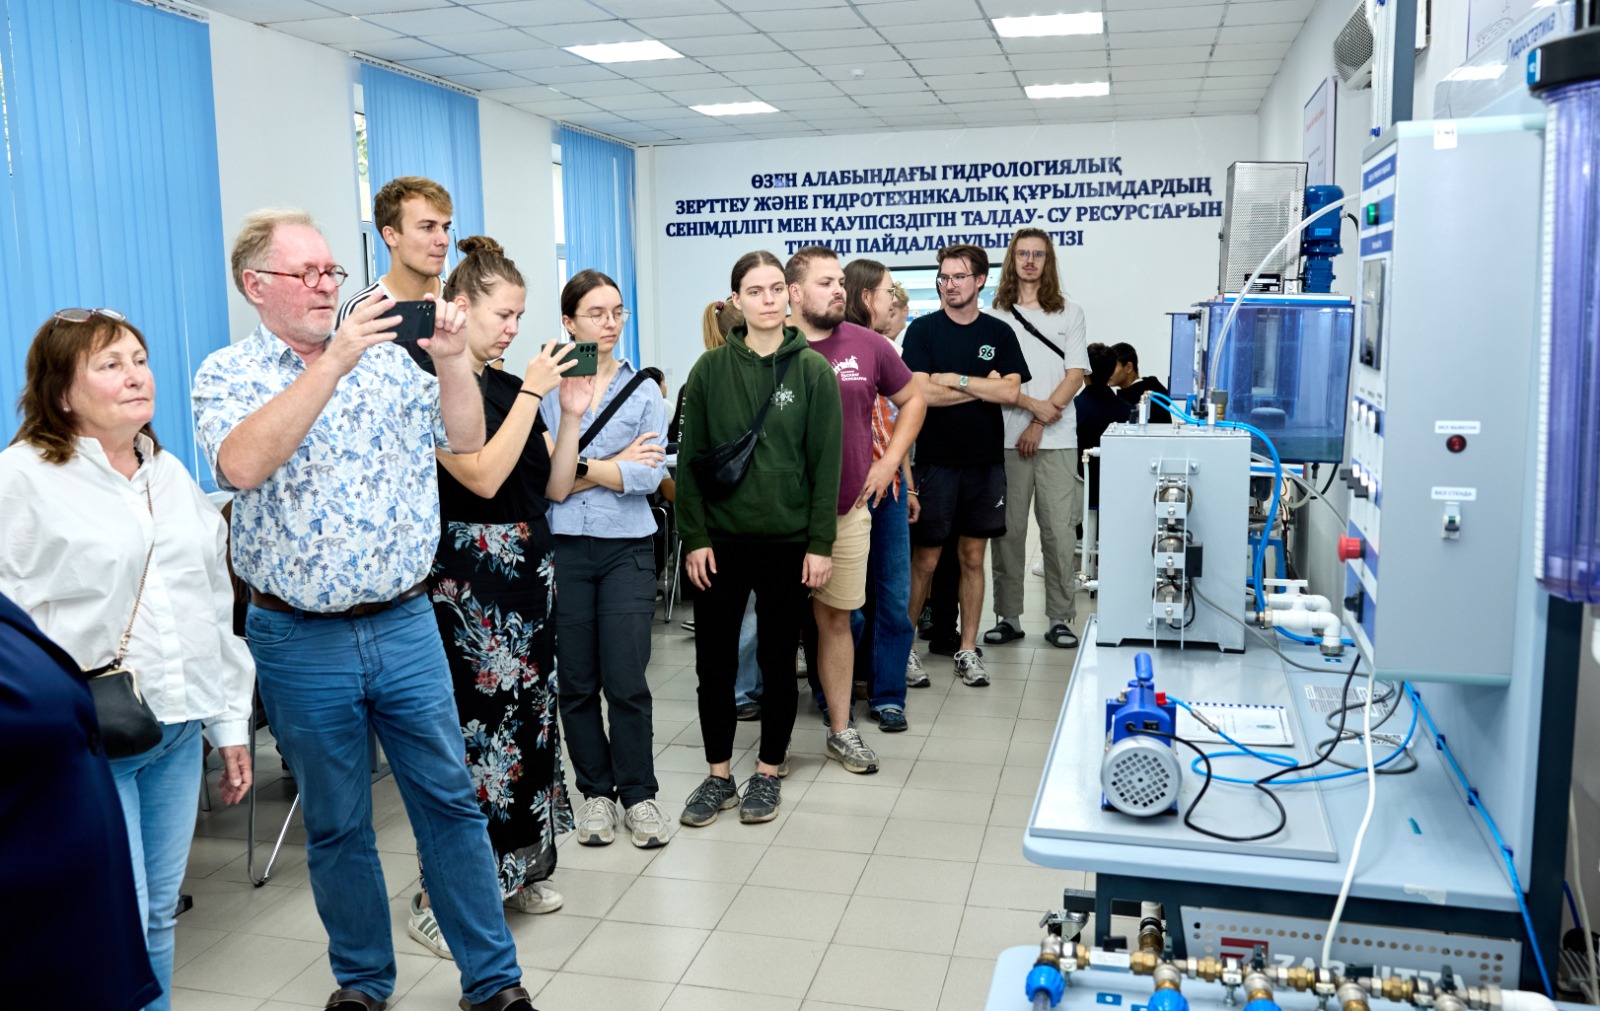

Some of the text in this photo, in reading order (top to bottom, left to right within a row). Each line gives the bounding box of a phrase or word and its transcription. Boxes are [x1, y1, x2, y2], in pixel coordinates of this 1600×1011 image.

[751, 157, 1123, 189] ӨЗЕН АЛАБЫНДАҒЫ ГИДРОЛОГИЯЛЫҚ
[675, 176, 1213, 215] ЗЕРТТЕУ ЖӘНЕ ГИДРОТЕХНИКАЛЫҚ ҚҰРЫЛЫМДАРДЫҢ
[665, 218, 774, 238] СЕНІМДІЛІГІ
[777, 216, 817, 234] МЕН
[820, 211, 957, 234] ҚАУІПСІЗДІГІН
[1047, 206, 1072, 223] СУ
[1075, 200, 1223, 222] РЕСУРСТАРЫН
[980, 347, 993, 358] 96
